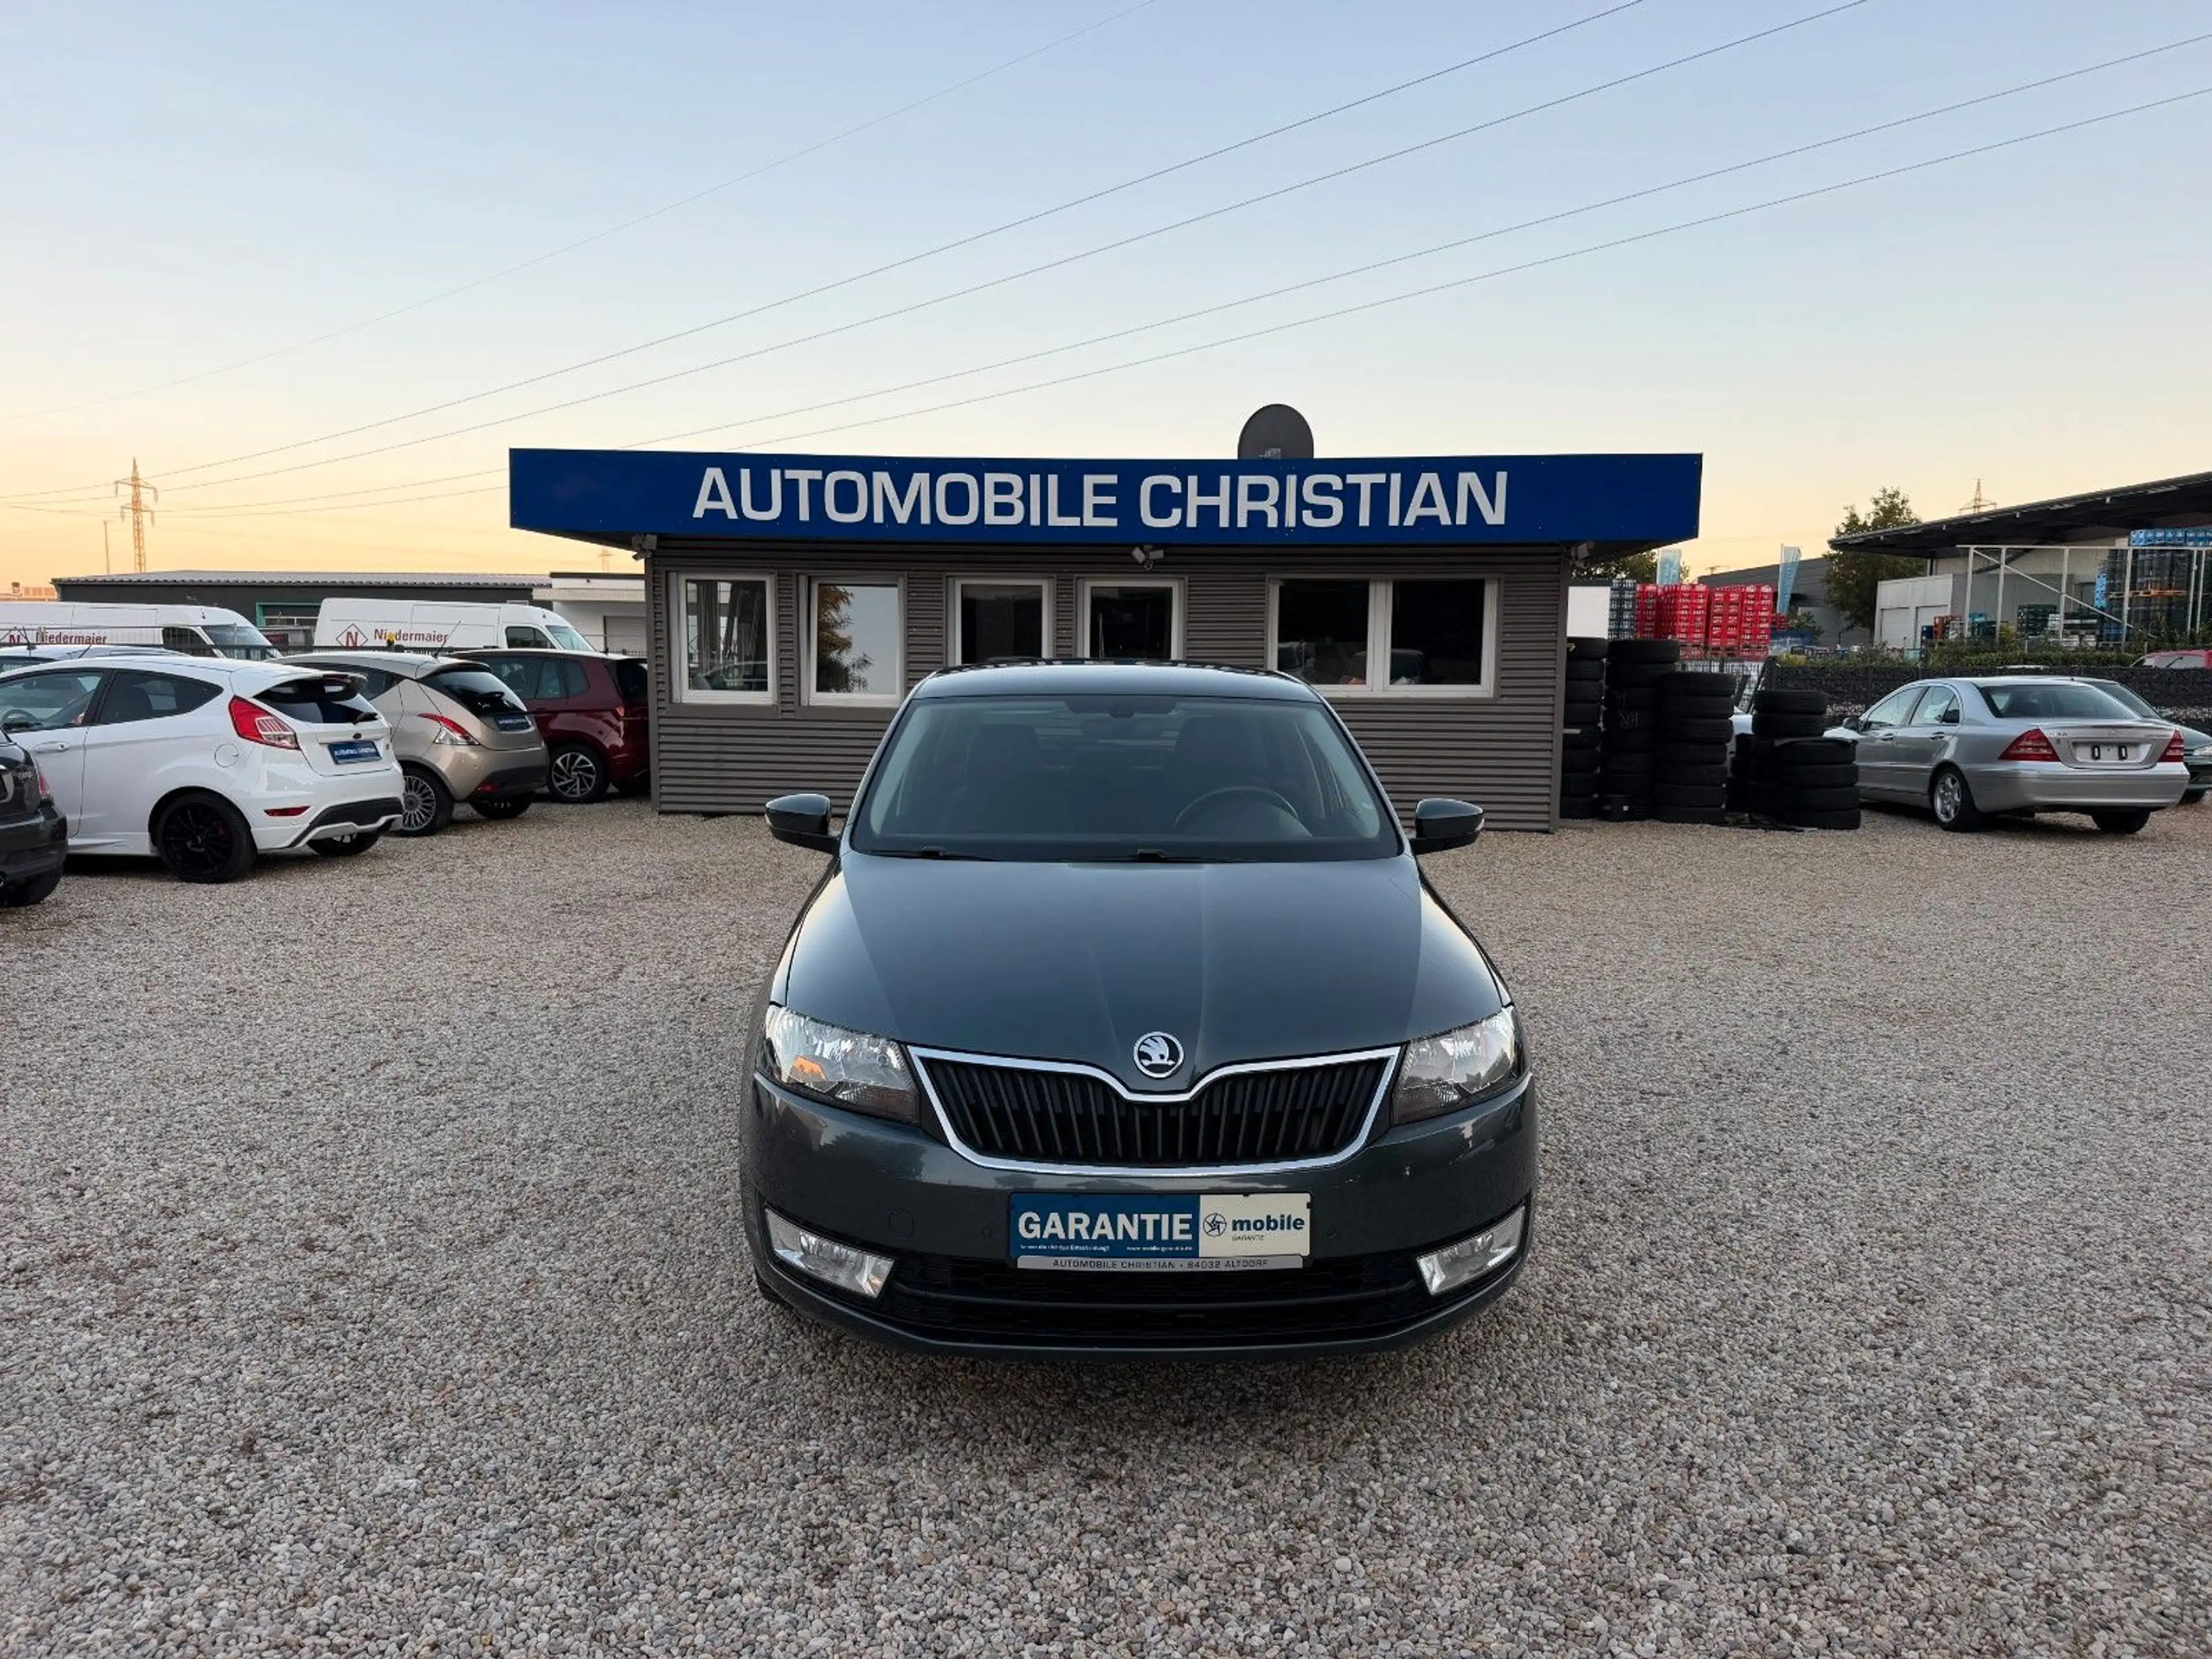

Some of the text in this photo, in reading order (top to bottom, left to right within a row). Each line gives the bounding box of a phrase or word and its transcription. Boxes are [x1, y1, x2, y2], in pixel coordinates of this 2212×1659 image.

[692, 467, 1508, 528] AUTOMOBILE CHRISTIAN
[346, 631, 358, 647] N
[374, 628, 448, 643] Nidermaier
[1018, 1211, 1192, 1240] GARANTIE
[1232, 1214, 1305, 1231] mobile
[1053, 1259, 1117, 1268] AUTOMOBILE
